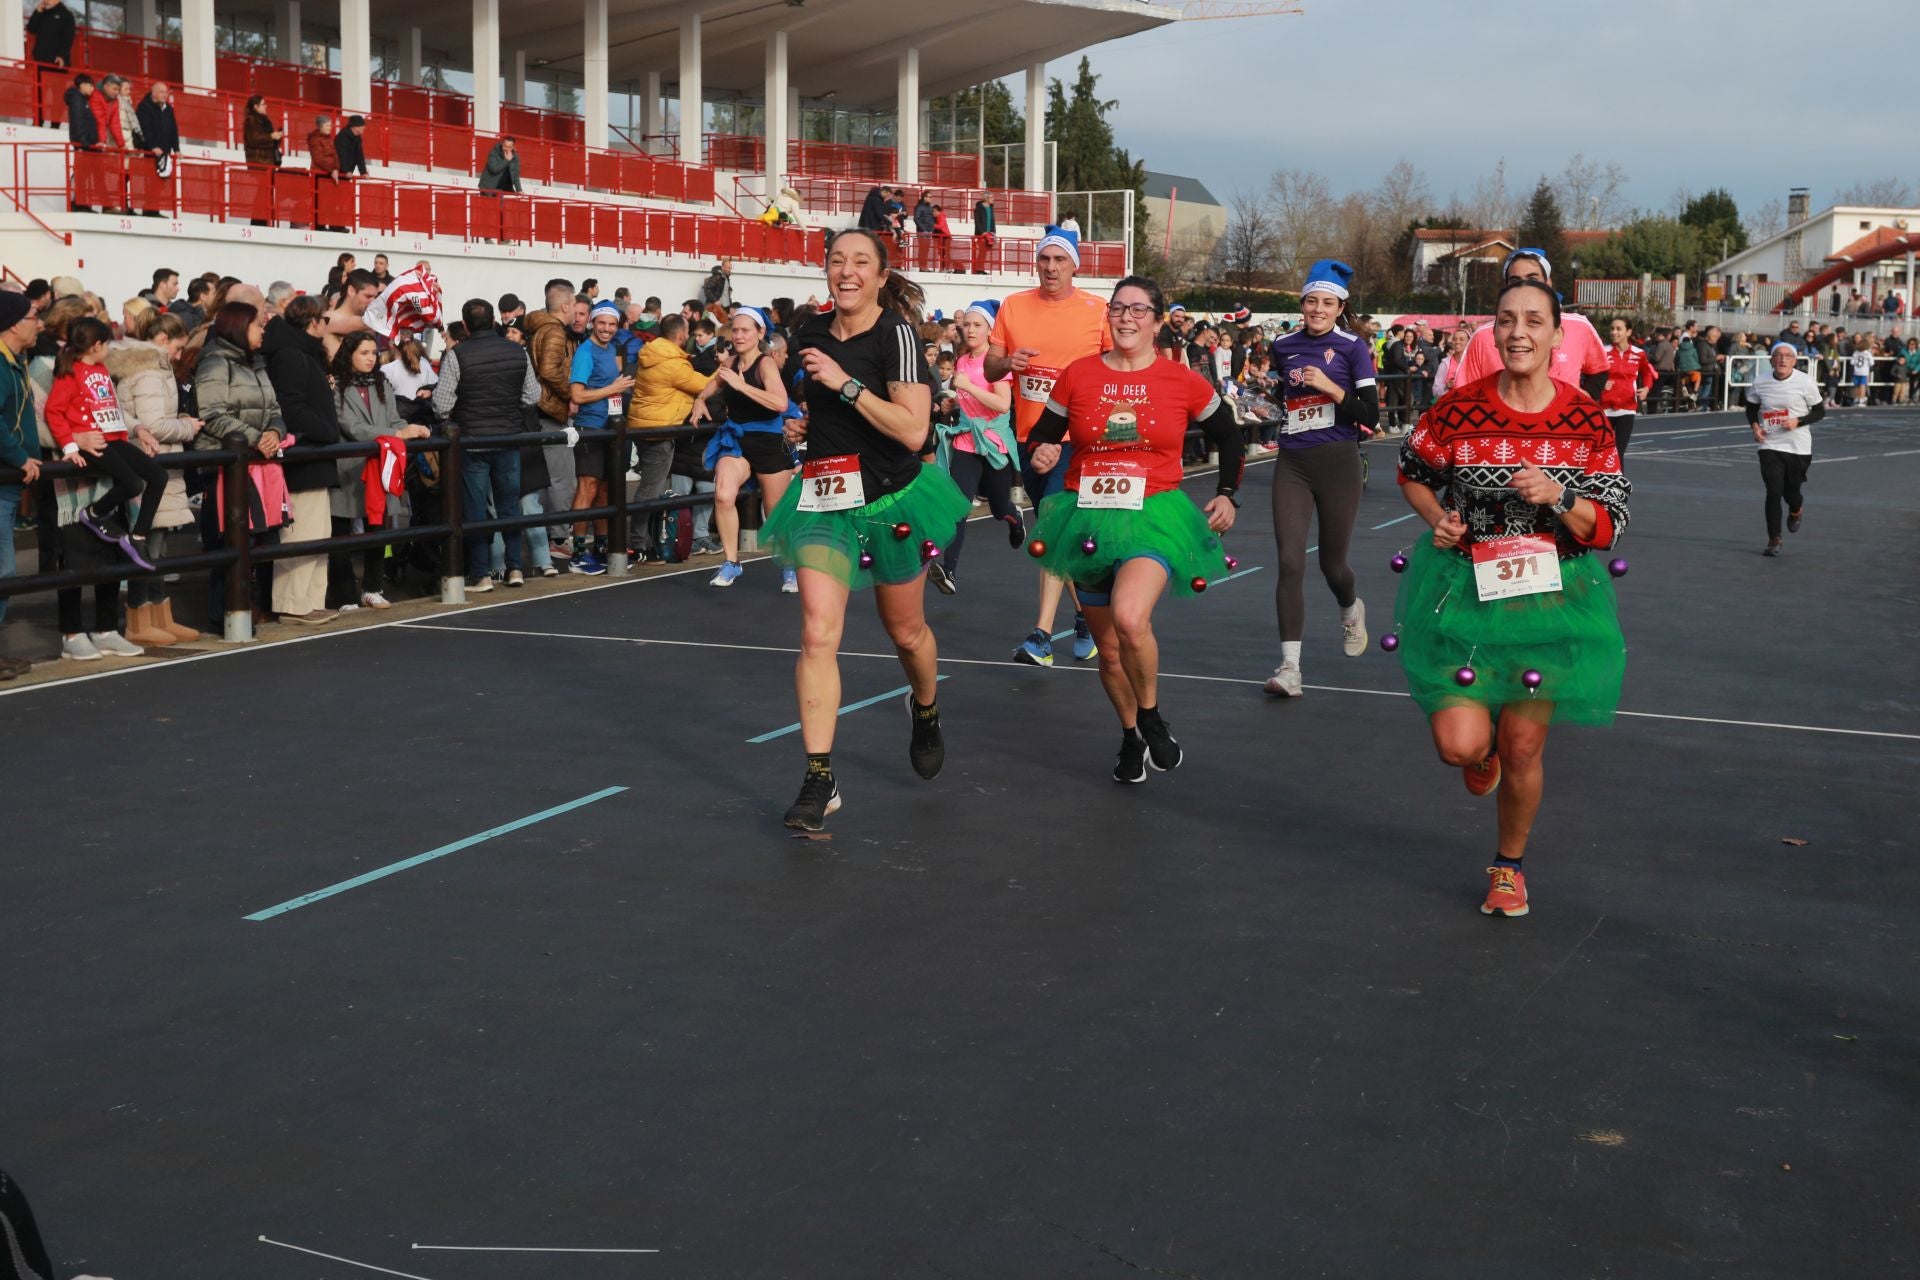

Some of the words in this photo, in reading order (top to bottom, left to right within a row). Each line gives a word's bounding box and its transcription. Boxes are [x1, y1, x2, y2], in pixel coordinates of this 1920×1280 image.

[1856, 355, 1865, 368] 8
[1026, 377, 1052, 392] 573
[1103, 383, 1118, 396] OH
[1123, 384, 1147, 396] DEER
[1298, 406, 1323, 421] 591
[815, 476, 847, 497] 372
[1092, 477, 1131, 495] 620
[1496, 556, 1540, 581] 371
